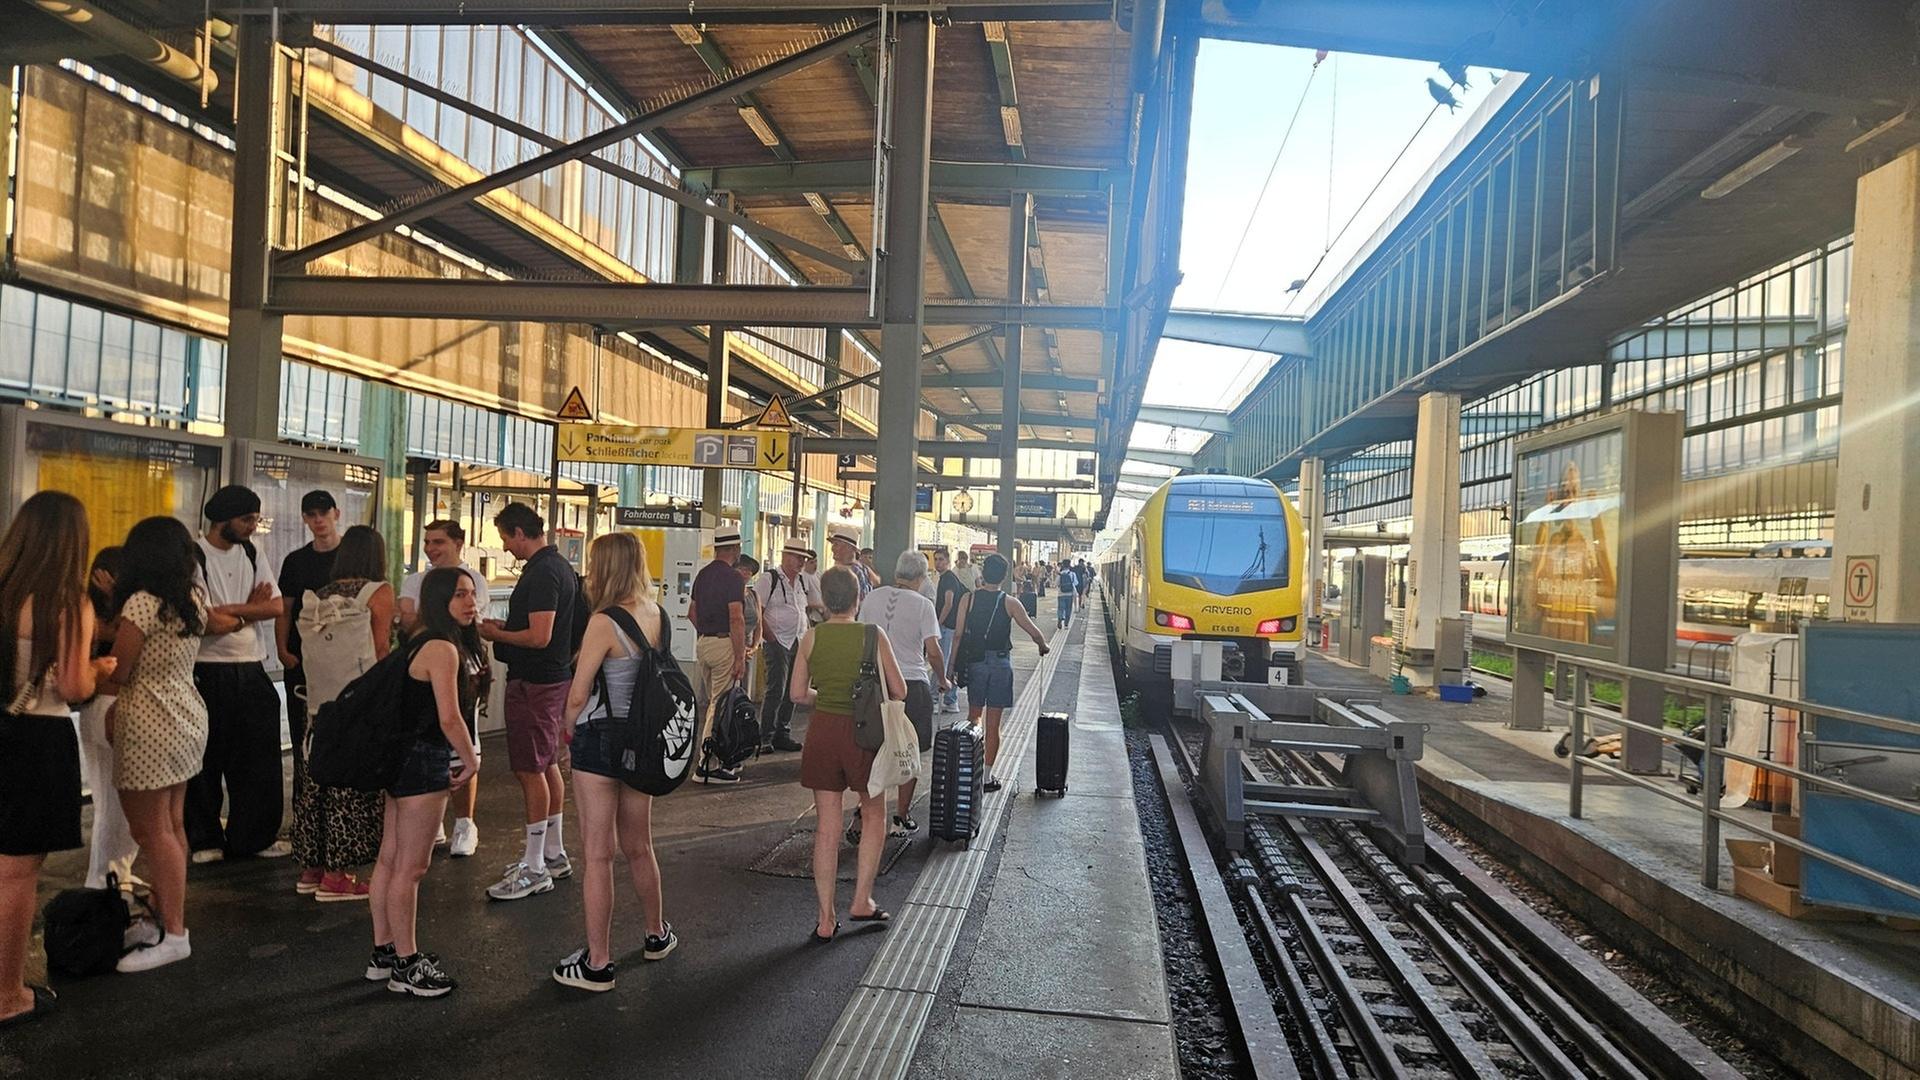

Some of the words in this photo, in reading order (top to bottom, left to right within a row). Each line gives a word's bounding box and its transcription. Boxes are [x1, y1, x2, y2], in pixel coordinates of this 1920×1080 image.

[586, 446, 660, 459] Schließfächer
[703, 442, 718, 463] P
[624, 509, 670, 520] Fahrkarten
[1201, 605, 1253, 616] ARVERIO
[1274, 670, 1282, 682] 4
